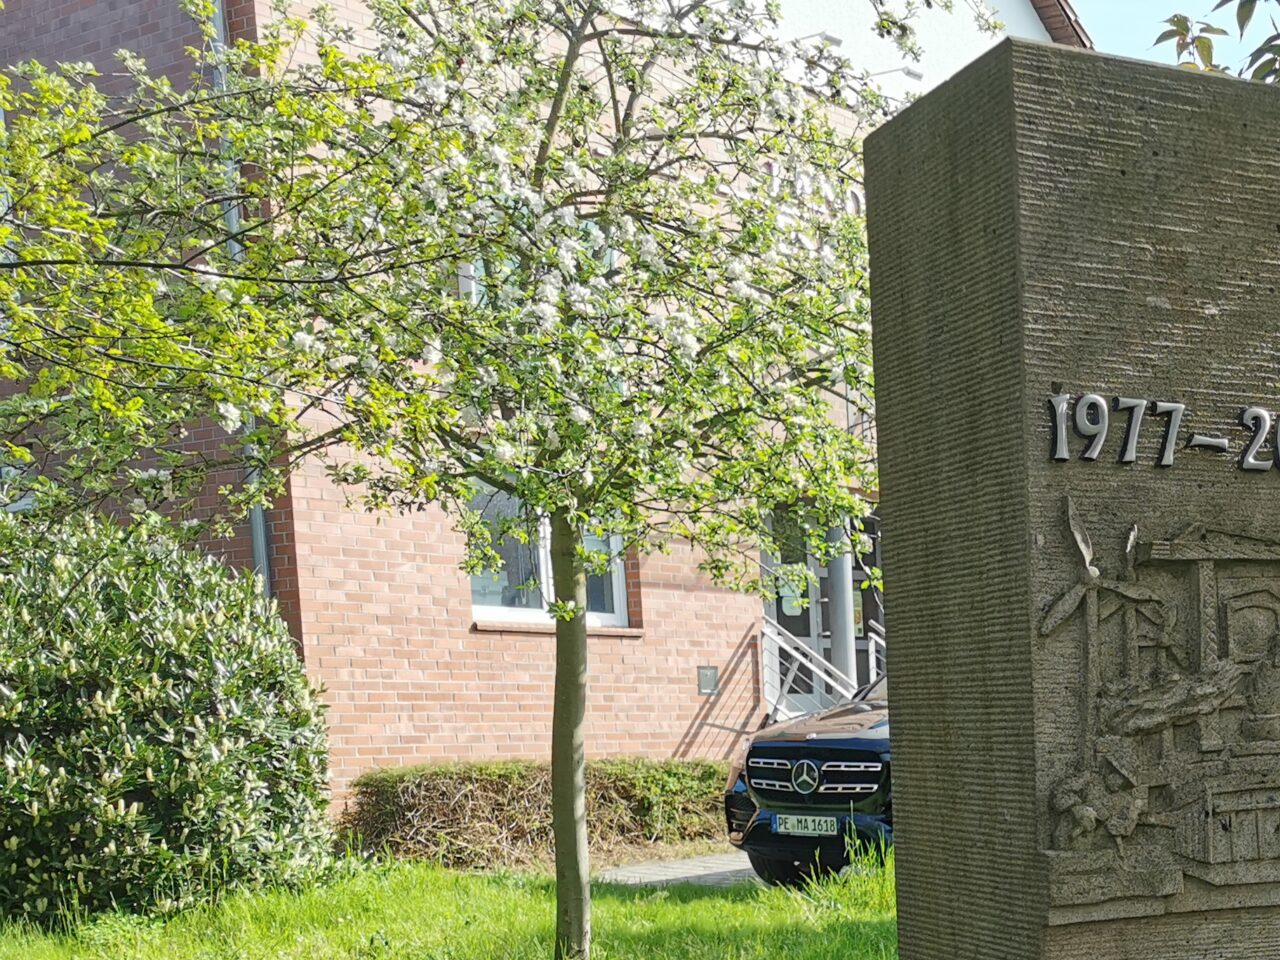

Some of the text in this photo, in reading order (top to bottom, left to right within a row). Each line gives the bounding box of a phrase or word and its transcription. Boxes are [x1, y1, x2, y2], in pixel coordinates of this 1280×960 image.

[778, 816, 836, 832] PE MA 1618
